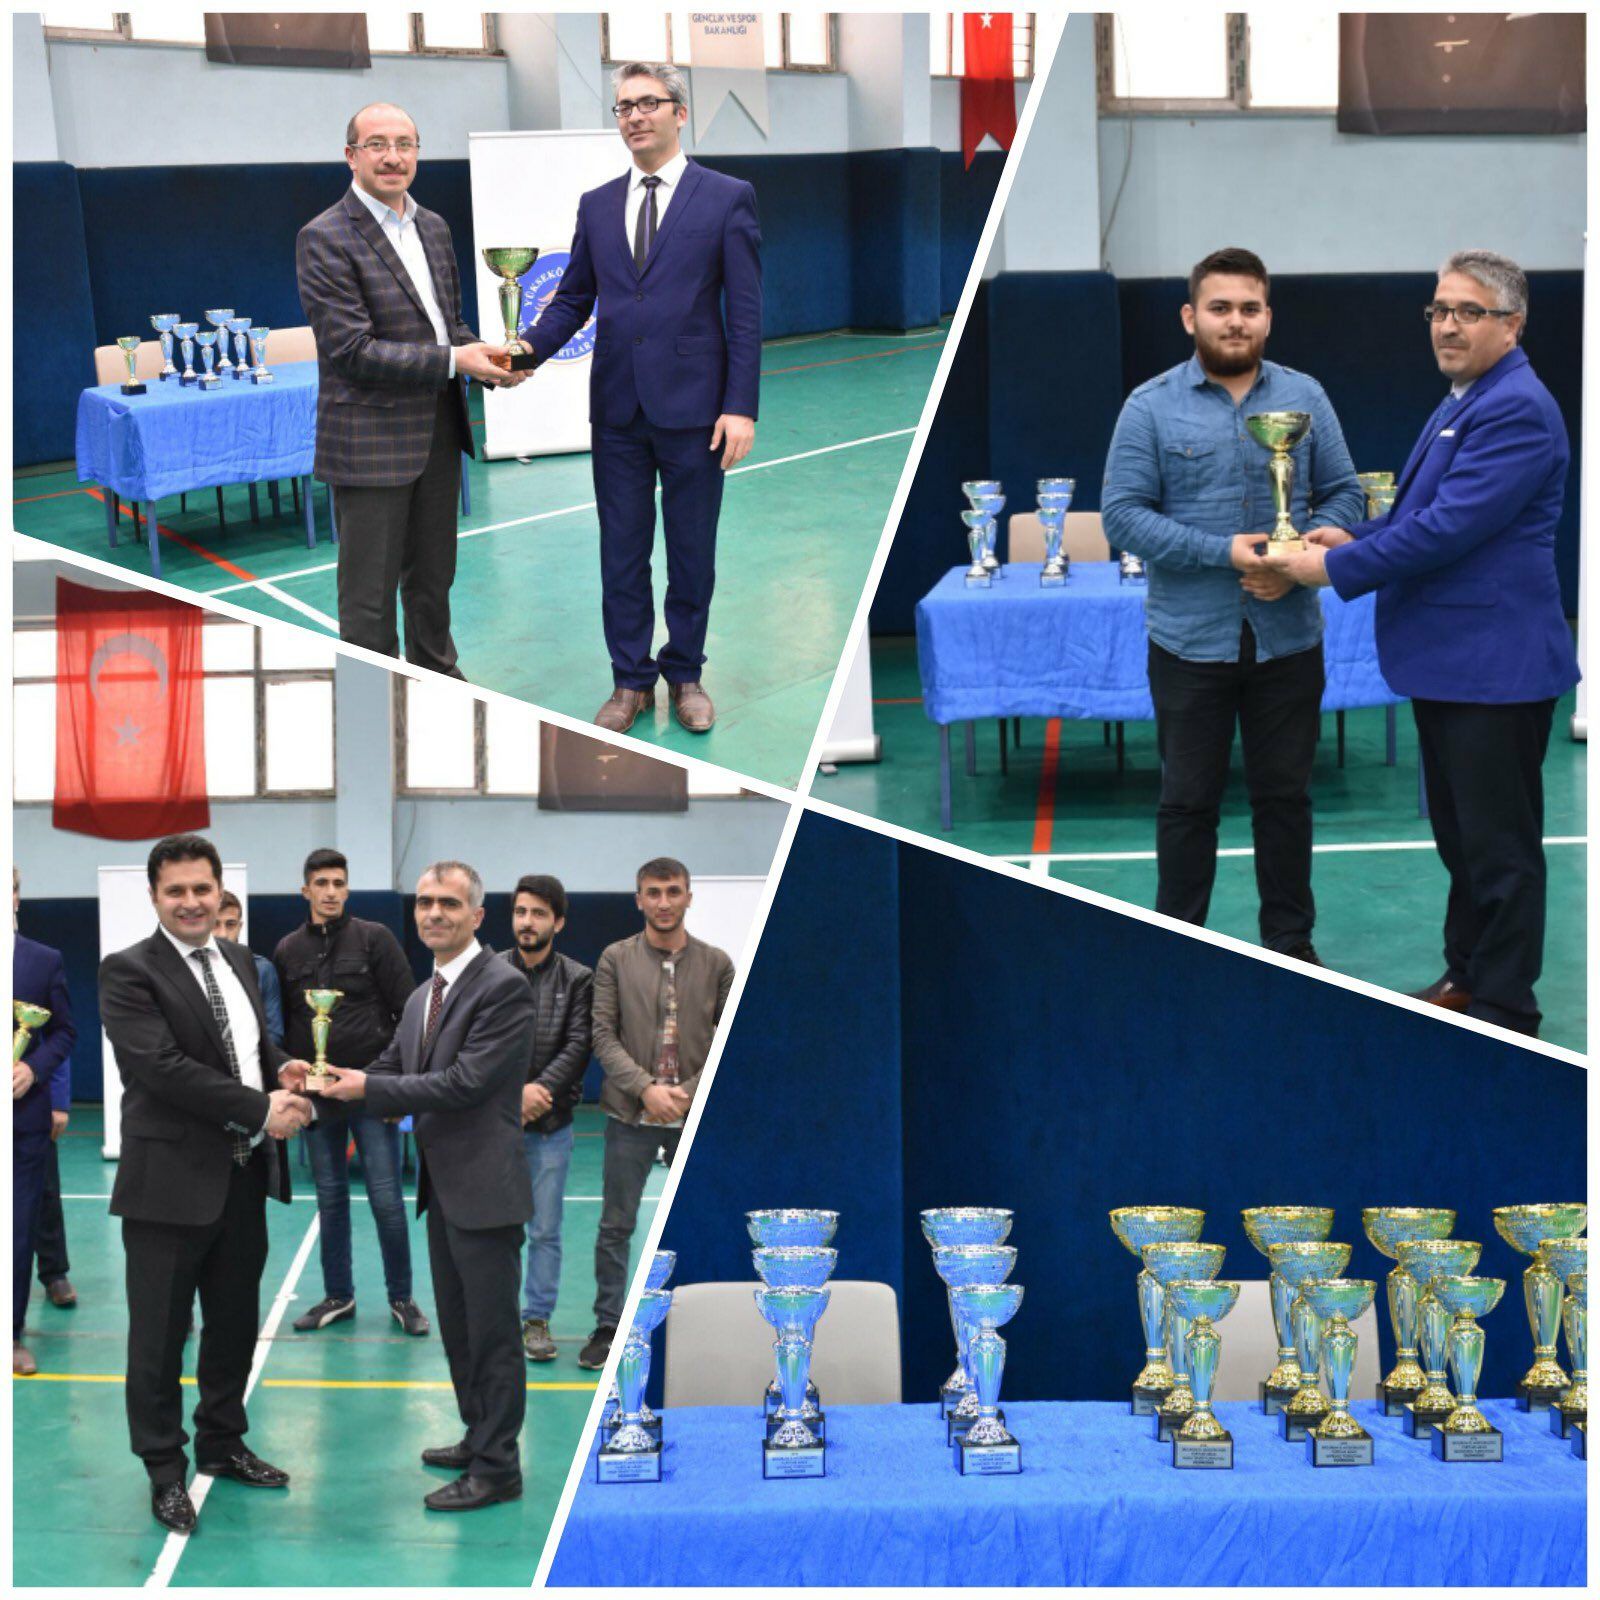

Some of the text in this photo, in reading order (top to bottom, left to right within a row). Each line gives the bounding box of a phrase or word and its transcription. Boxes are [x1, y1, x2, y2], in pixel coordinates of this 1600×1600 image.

[726, 13, 737, 23] VE
[737, 13, 757, 23] SPOR
[524, 266, 564, 306] YÜKSEKÖ
[557, 341, 592, 358] RTLAR
